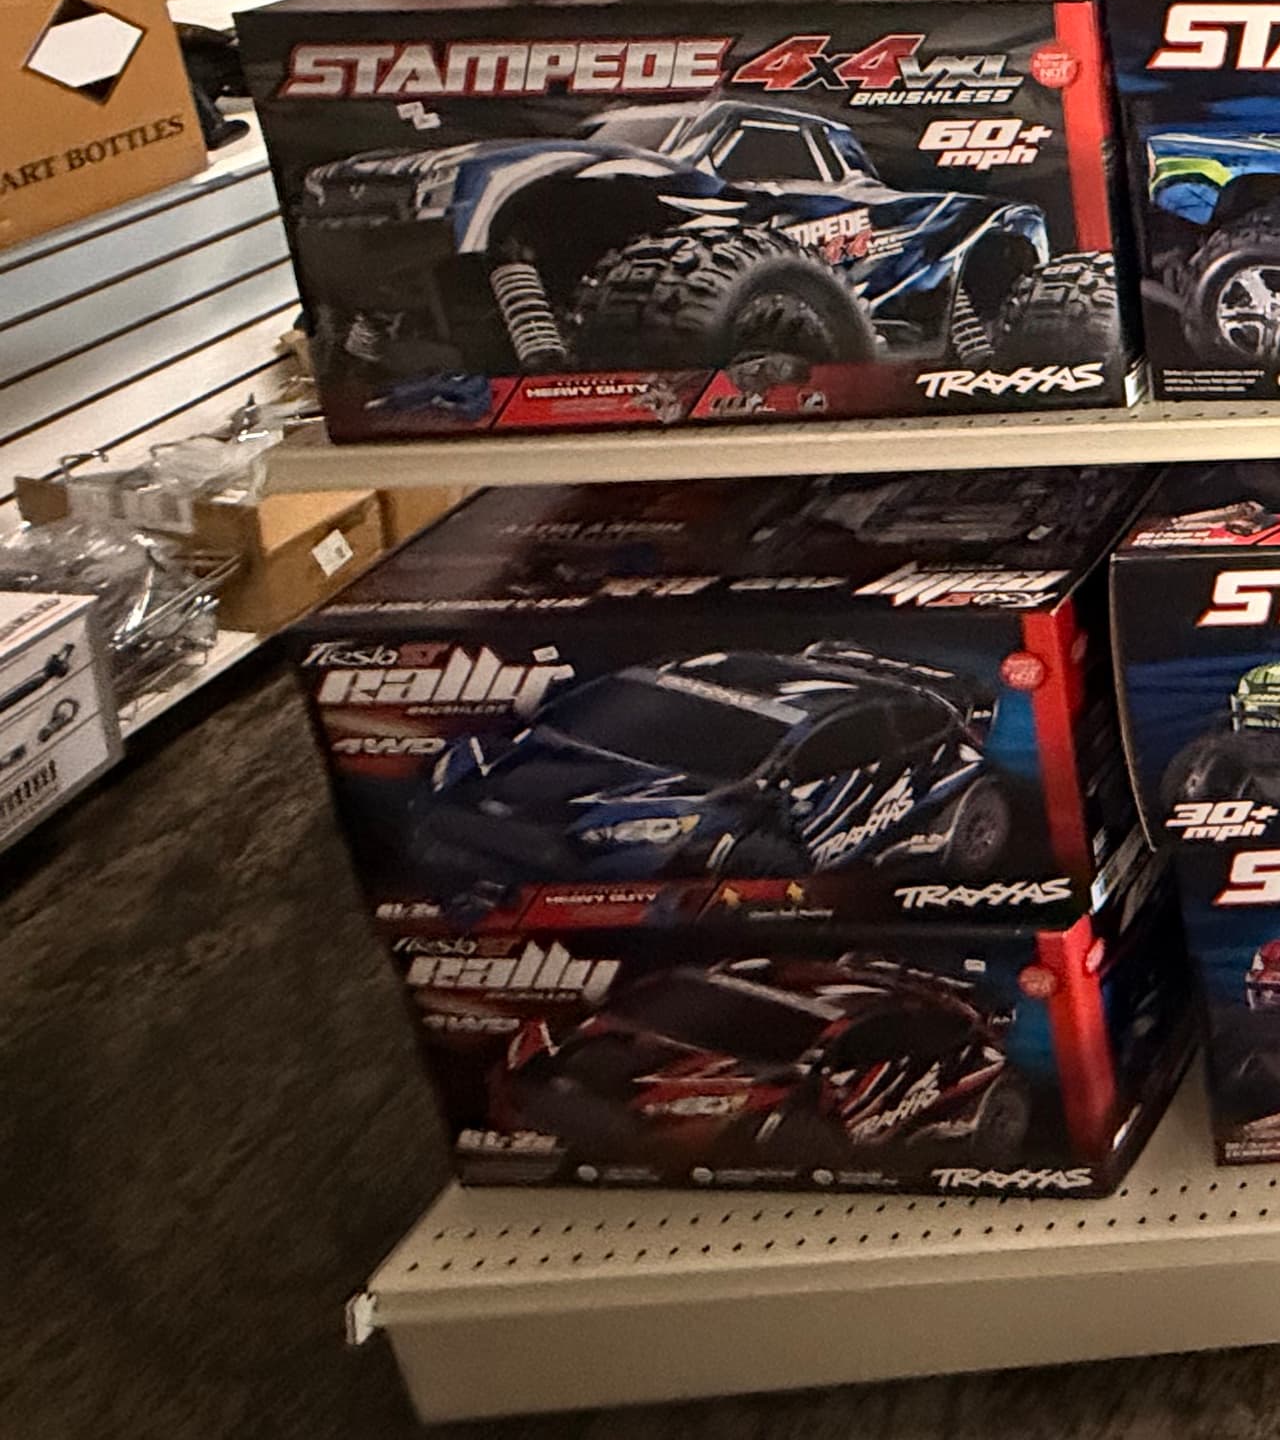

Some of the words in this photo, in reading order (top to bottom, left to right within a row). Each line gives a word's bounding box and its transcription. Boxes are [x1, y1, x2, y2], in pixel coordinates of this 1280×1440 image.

[279, 35, 736, 98] STAMPEDE
[899, 55, 1024, 88] VXL
[850, 89, 1013, 106] BRUSHLESS
[918, 118, 1053, 150] 60+
[0, 157, 58, 197] ART
[64, 115, 187, 171] BOTTLES
[938, 148, 1038, 171] mph
[526, 384, 593, 398] HEAVY
[597, 382, 650, 396] DUTY
[916, 363, 1105, 401] TRAXXAS
[301, 641, 399, 667] Fiesta
[331, 737, 447, 755] 4WD
[1166, 800, 1279, 828] 30+
[812, 791, 914, 867] TRAXXAS
[1183, 820, 1266, 842] mph
[893, 878, 1072, 910] TRAXXAS
[929, 1167, 1093, 1190] TRAXXAS
